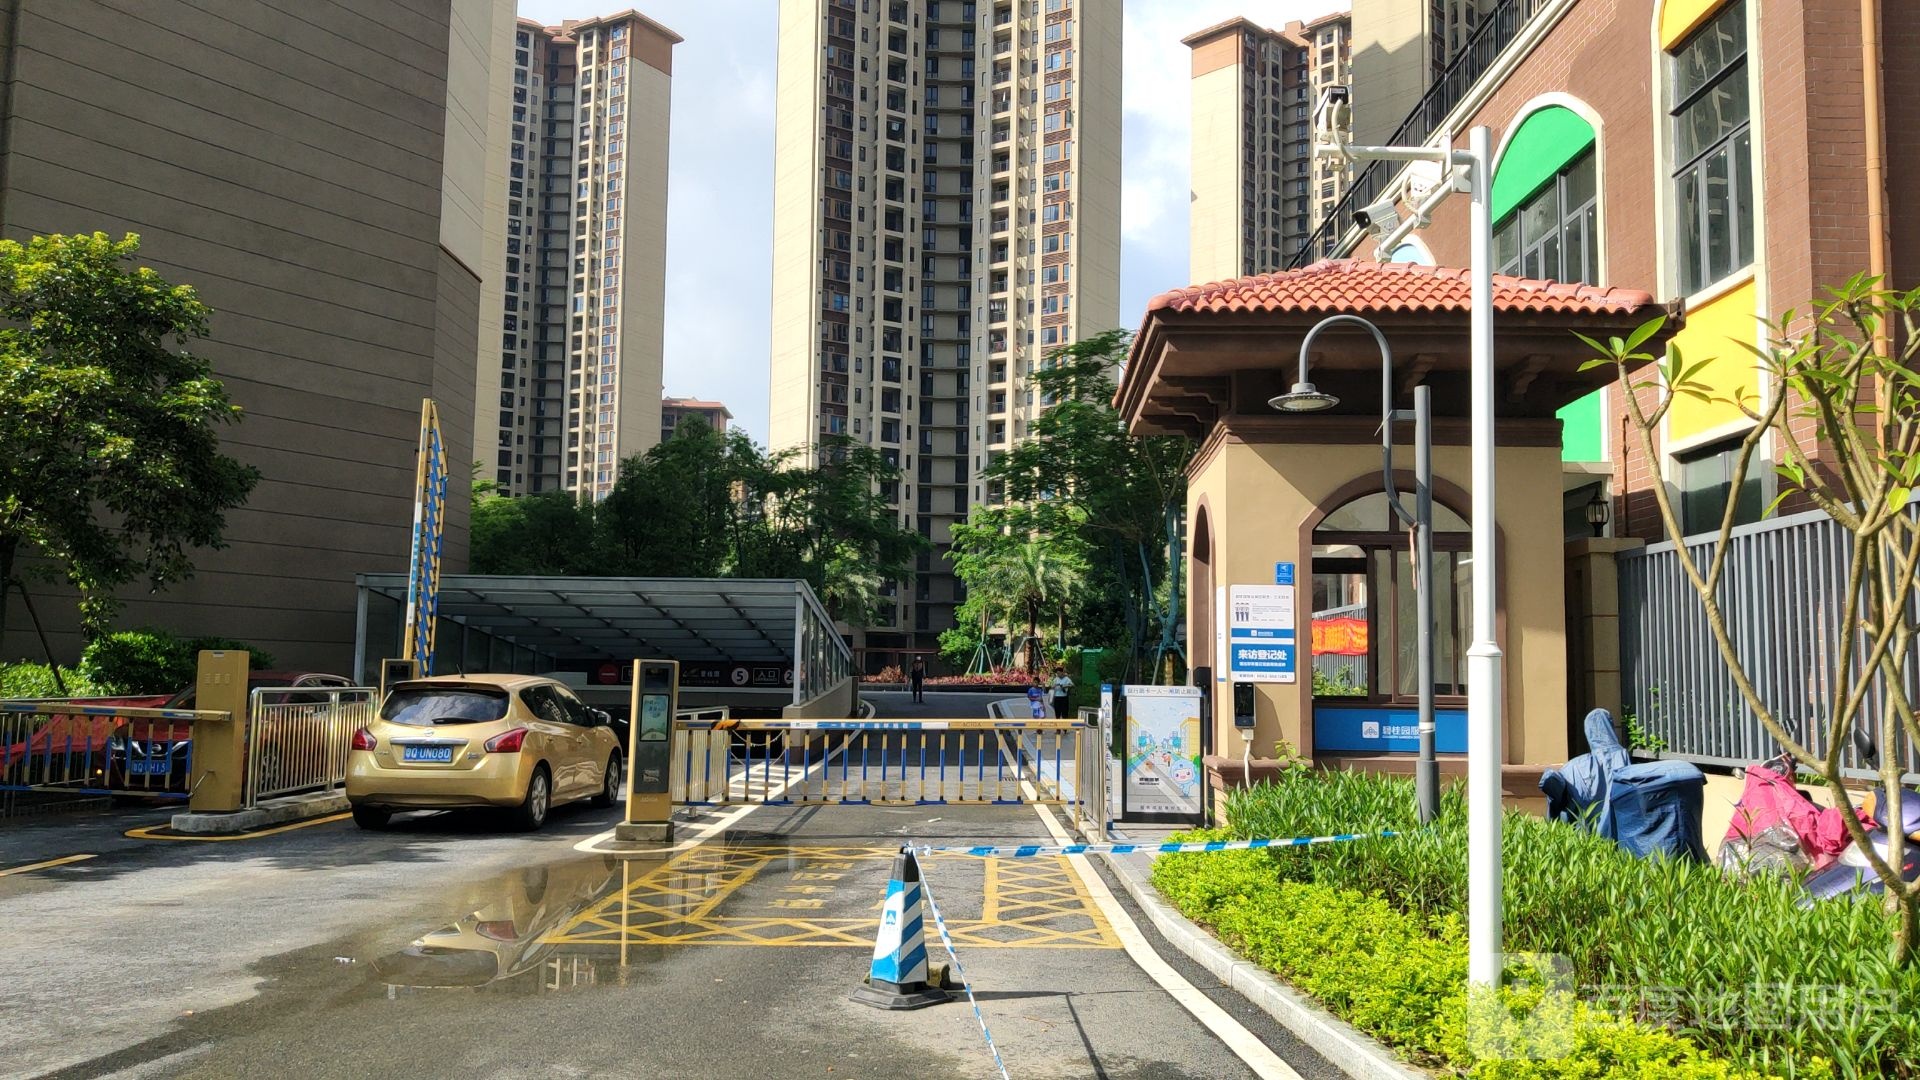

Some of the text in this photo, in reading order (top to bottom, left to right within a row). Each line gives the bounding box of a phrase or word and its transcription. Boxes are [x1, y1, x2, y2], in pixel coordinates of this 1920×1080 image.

[1238, 649, 1288, 660] 来访登记处
